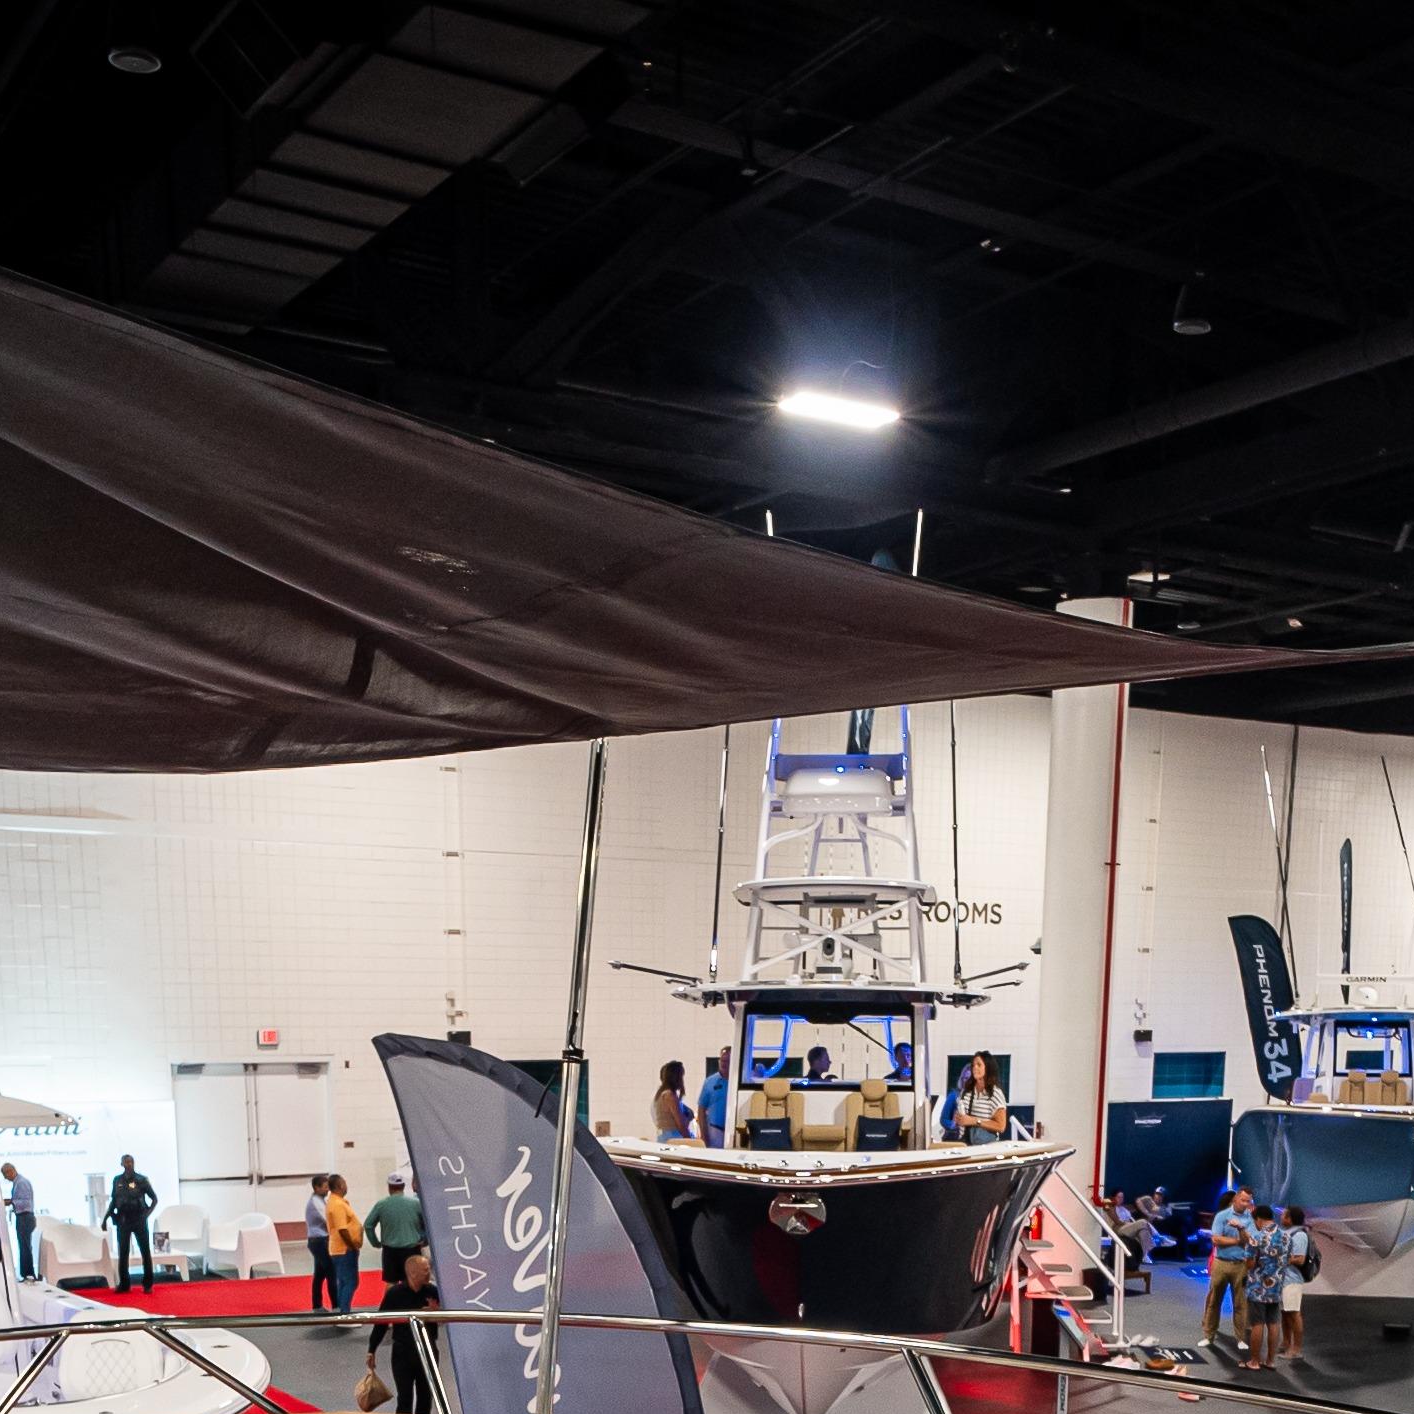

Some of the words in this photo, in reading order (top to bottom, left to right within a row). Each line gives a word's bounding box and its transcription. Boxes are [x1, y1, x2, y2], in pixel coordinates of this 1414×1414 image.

[858, 901, 1002, 925] SROOMS
[1253, 944, 1278, 1037] PHENOM
[1264, 1038, 1292, 1083] 34
